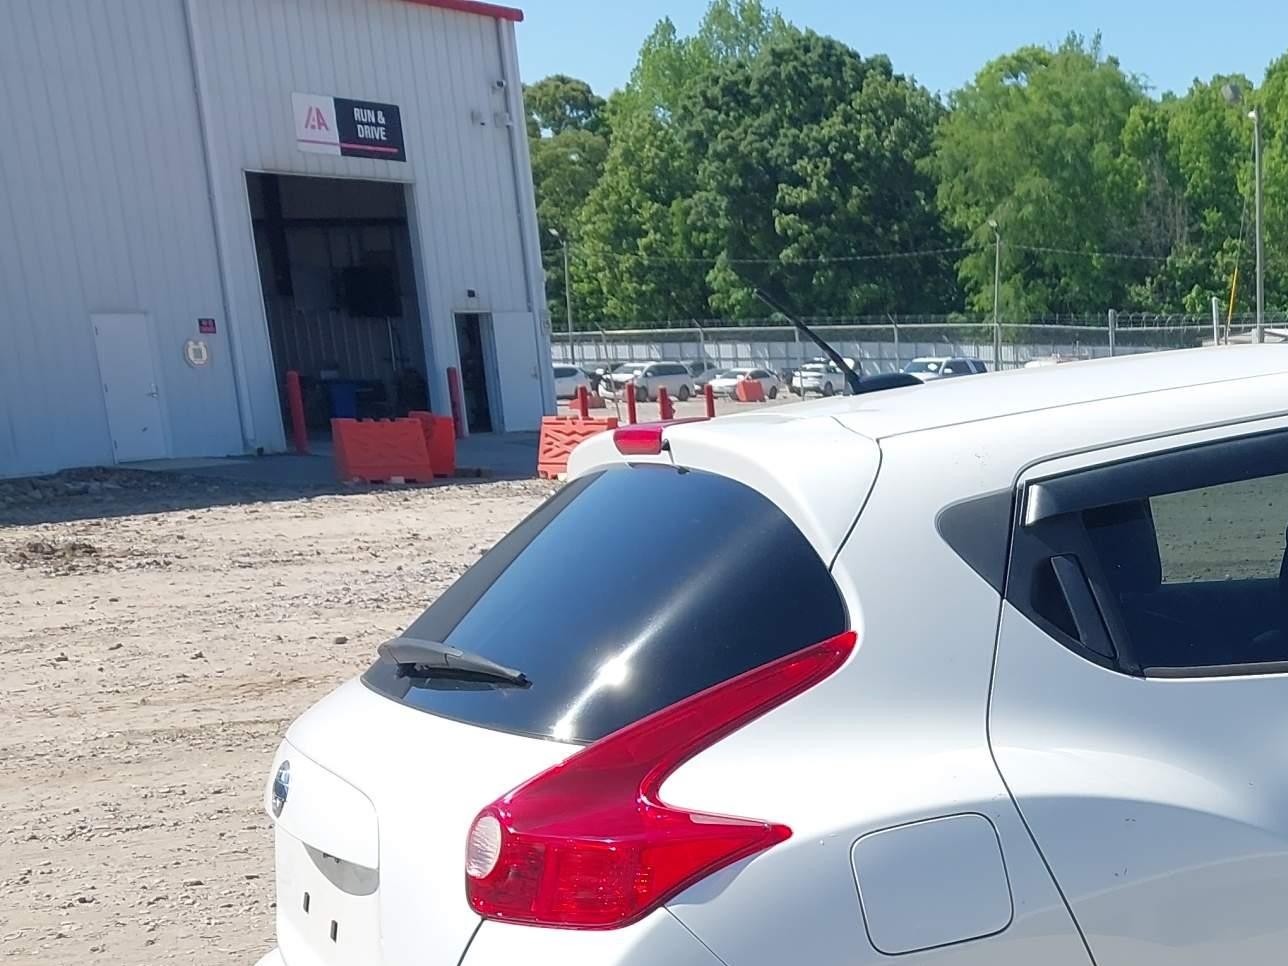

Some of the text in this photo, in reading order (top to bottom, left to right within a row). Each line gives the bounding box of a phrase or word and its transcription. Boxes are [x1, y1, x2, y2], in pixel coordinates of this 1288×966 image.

[353, 107, 386, 124] RUN &
[356, 124, 387, 140] DRIVE
